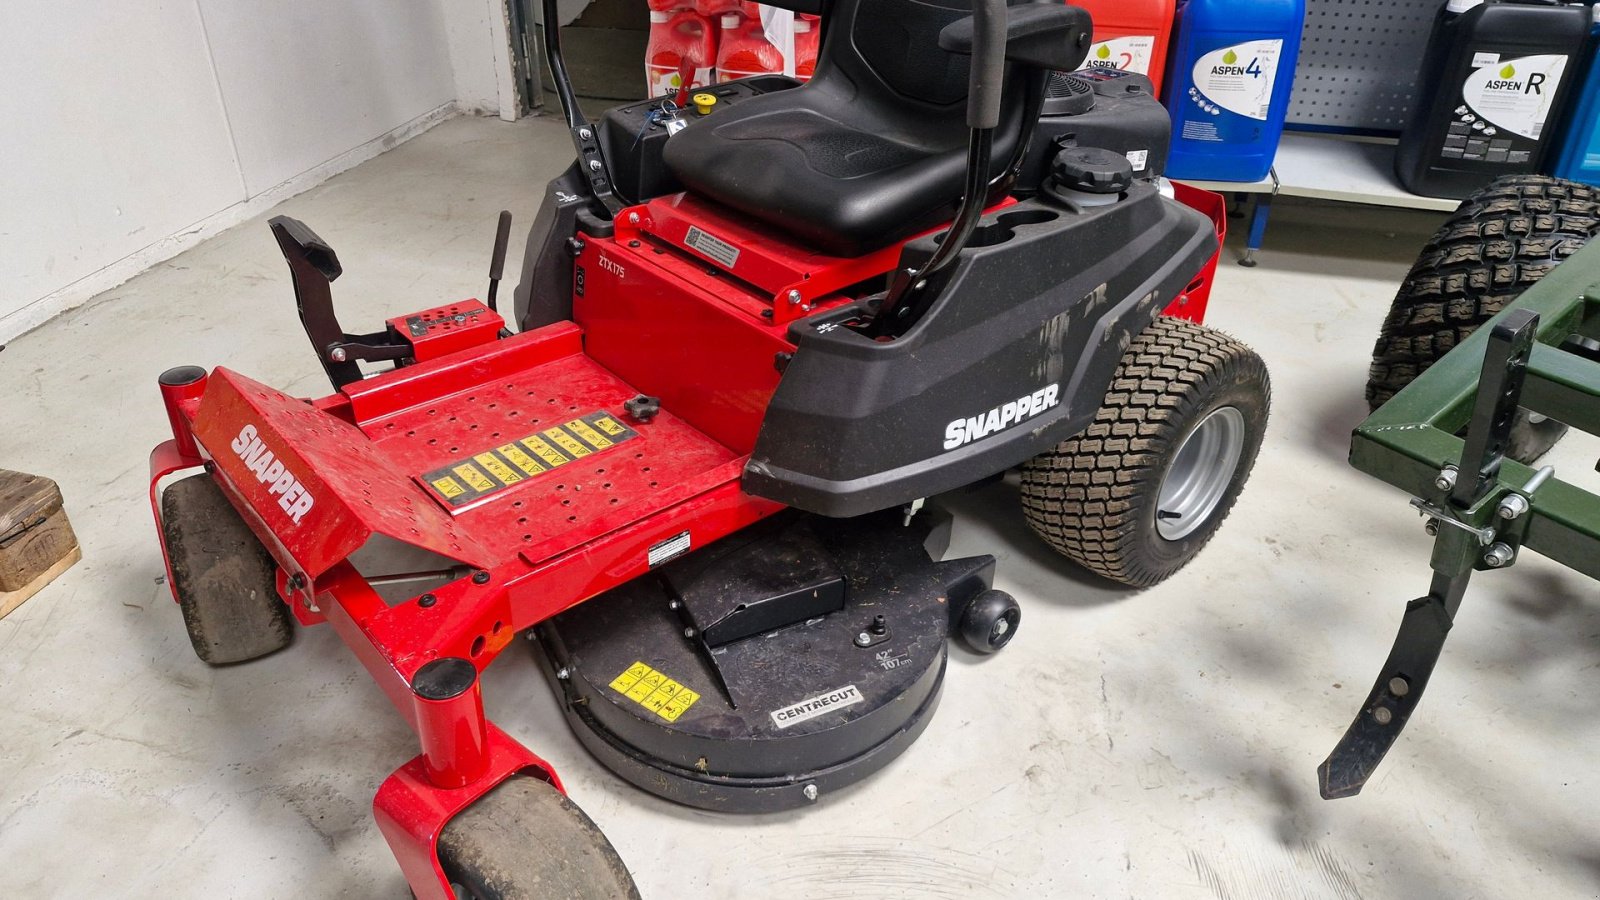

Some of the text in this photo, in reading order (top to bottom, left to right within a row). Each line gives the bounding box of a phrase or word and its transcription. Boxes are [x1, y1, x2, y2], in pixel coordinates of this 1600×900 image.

[1086, 53, 1132, 70] ASPEN 2
[1211, 57, 1261, 78] ASPEN 4
[1485, 72, 1545, 94] ASPEN R
[599, 255, 625, 278] ZTX175
[944, 383, 1059, 450] SNAPPER
[231, 424, 315, 525] SNAPPER
[776, 688, 855, 720] CENTRECUT
